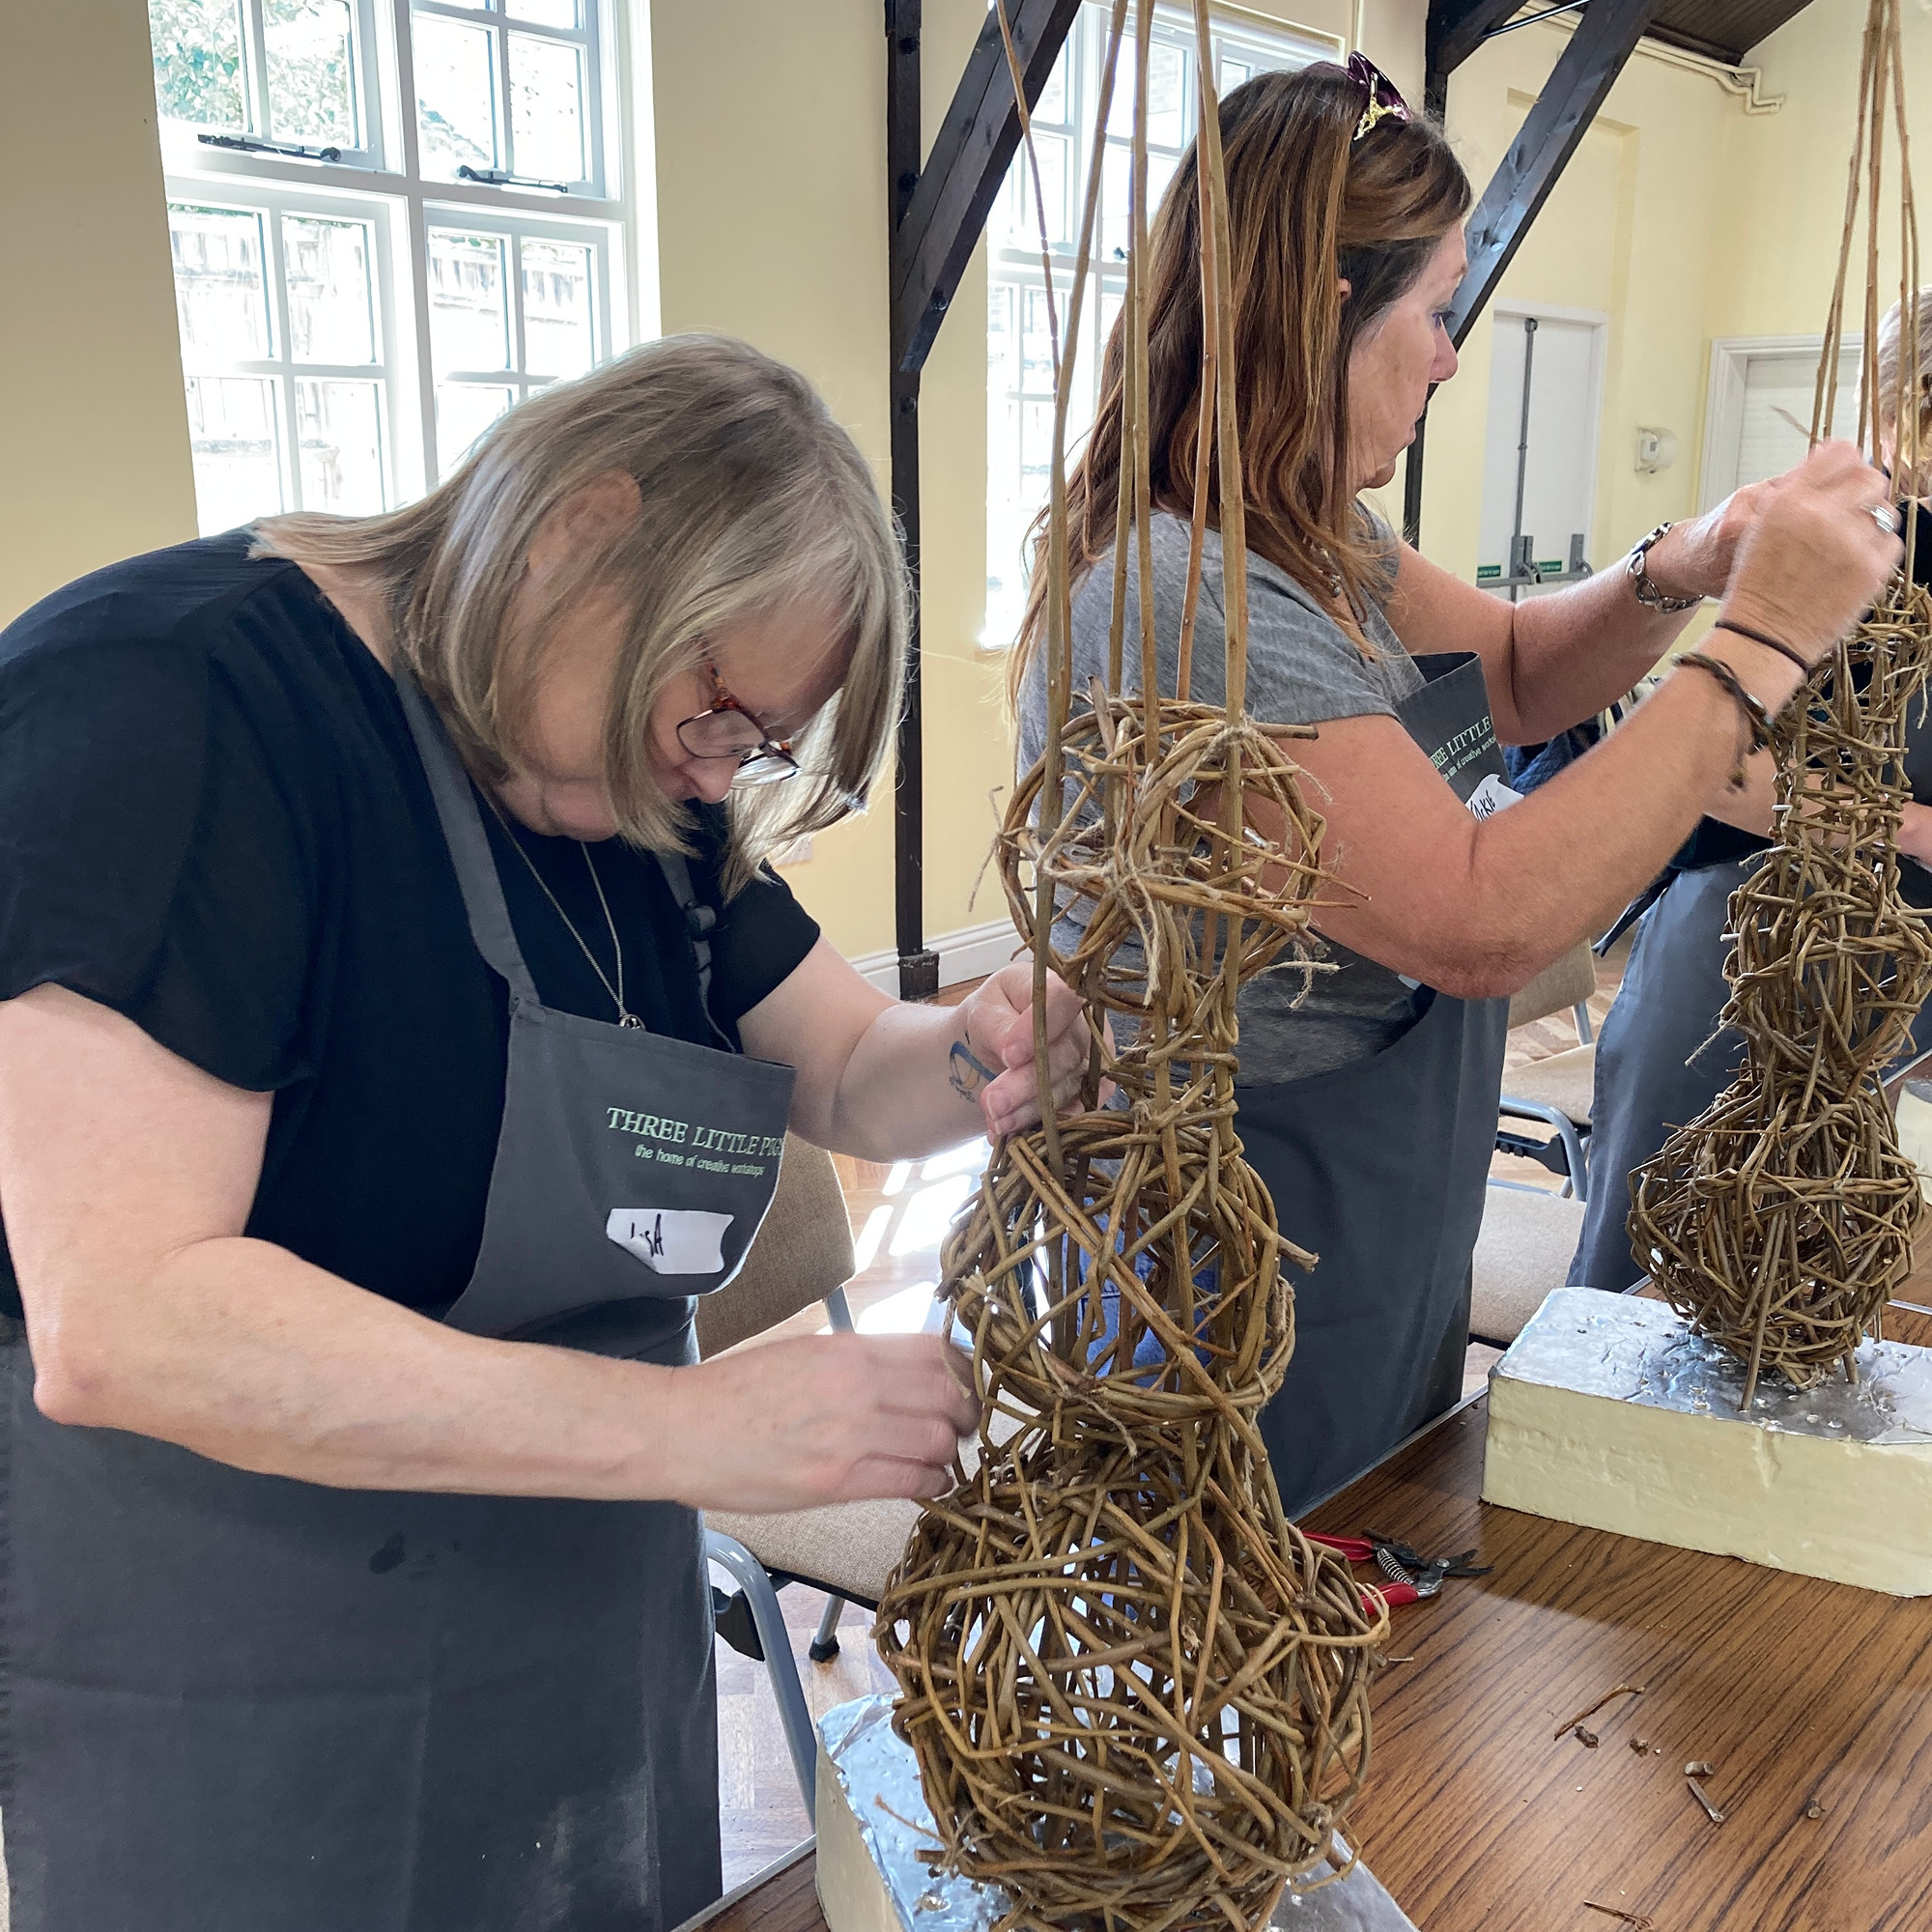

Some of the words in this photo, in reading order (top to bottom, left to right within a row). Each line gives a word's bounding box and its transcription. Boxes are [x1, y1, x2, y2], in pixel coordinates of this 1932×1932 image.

[1429, 747, 1449, 770] REE
[1446, 716, 1492, 756] LITTLE
[606, 1107, 689, 1144] THREE
[691, 1126, 761, 1155] LITTLE
[634, 1144, 653, 1159] the
[655, 1148, 684, 1166] home
[685, 1154, 698, 1168] of
[696, 1157, 729, 1174] creative
